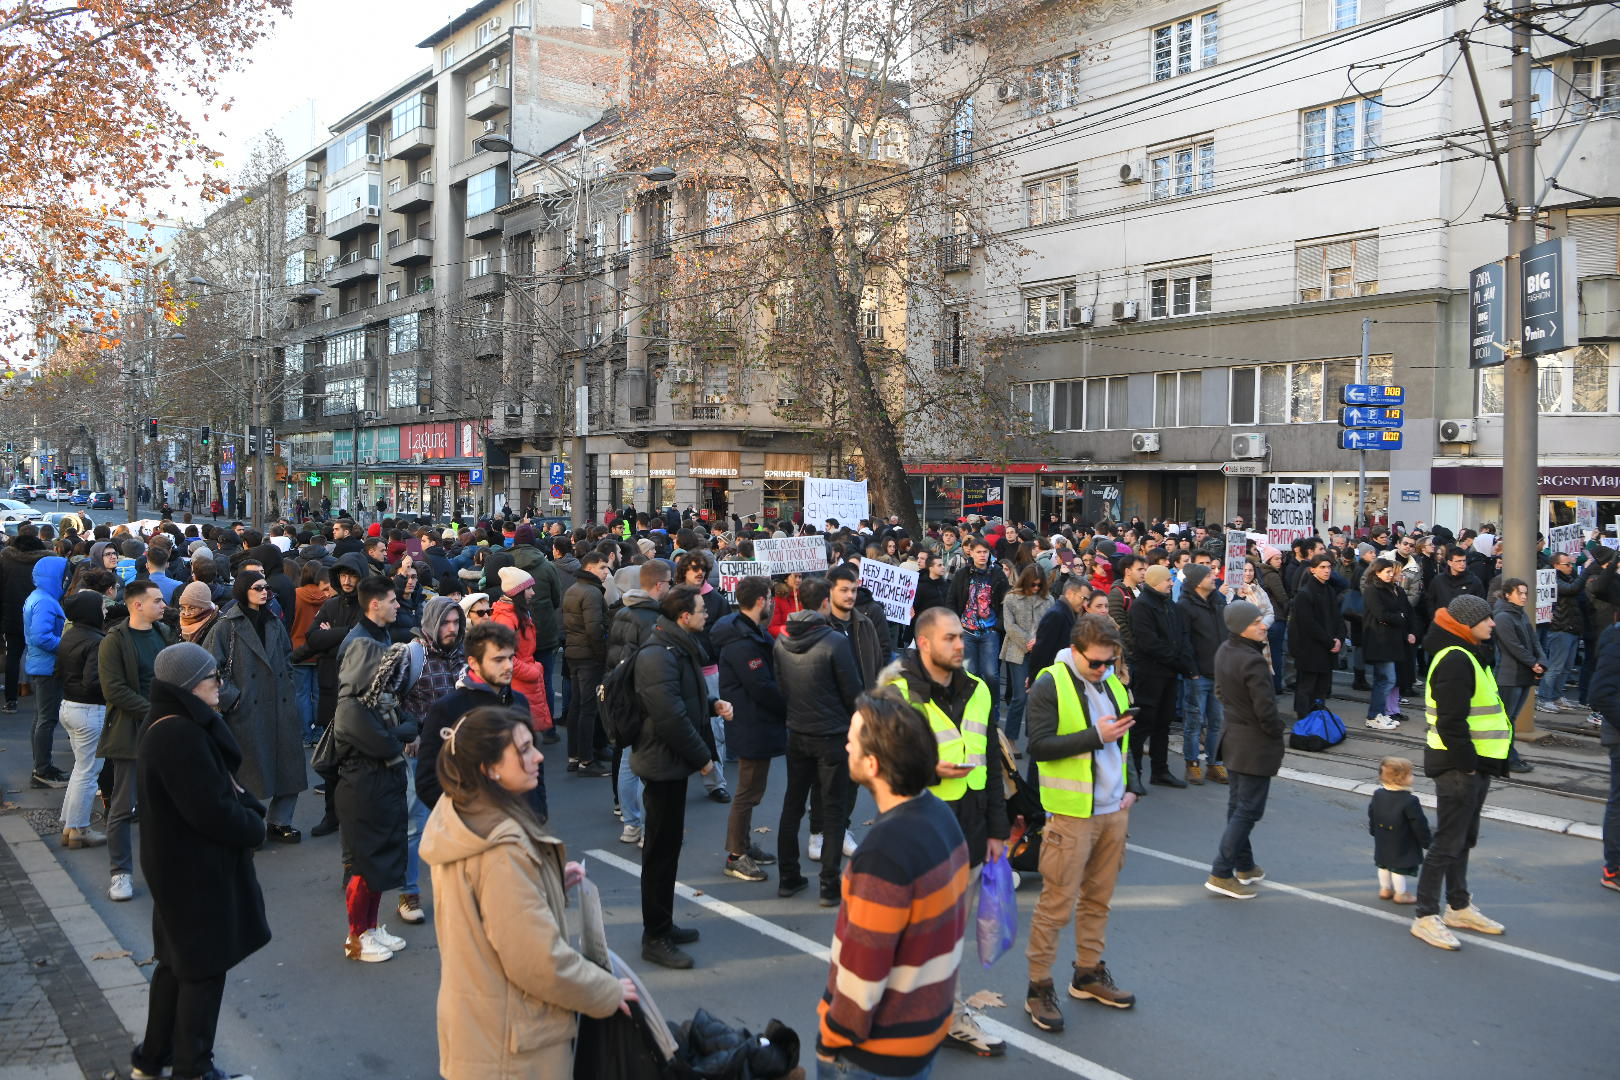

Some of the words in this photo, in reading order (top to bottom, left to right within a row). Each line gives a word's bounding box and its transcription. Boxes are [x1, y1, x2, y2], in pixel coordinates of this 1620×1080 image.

[1527, 271, 1551, 294] BIG
[1527, 290, 1551, 303] FASHION
[408, 431, 448, 454] Laguna
[1368, 432, 1375, 441] P
[472, 470, 480, 480] P
[553, 464, 561, 475] P
[689, 467, 738, 476] SPRINGFIELD
[764, 470, 811, 478] SPRINGFIELD
[1270, 488, 1296, 504] СЛАБА
[1297, 488, 1312, 504] ВАМ
[720, 562, 762, 576] СТУДЕНТИ
[862, 562, 881, 579] НЕЋУ
[882, 568, 895, 583] ДА
